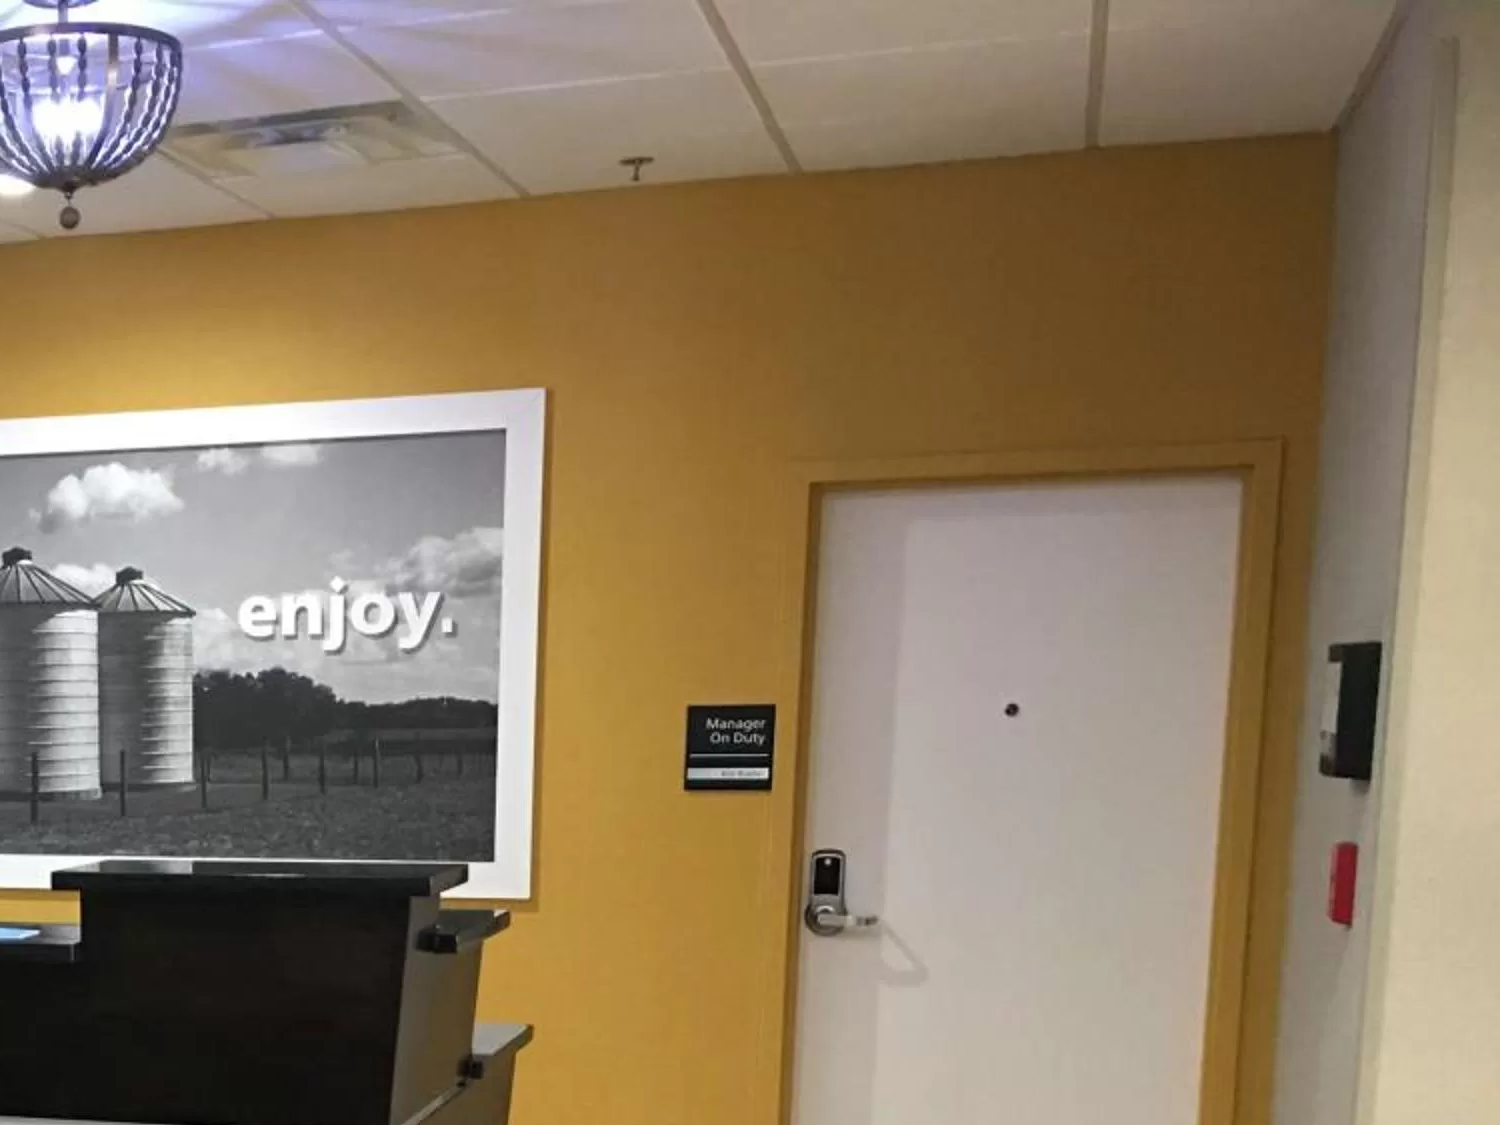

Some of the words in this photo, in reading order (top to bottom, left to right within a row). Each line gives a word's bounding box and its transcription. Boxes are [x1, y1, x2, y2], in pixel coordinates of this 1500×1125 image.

[238, 575, 456, 654] enjoy.
[705, 717, 767, 733] Manager
[709, 732, 730, 744] On
[733, 731, 766, 747] Duty
